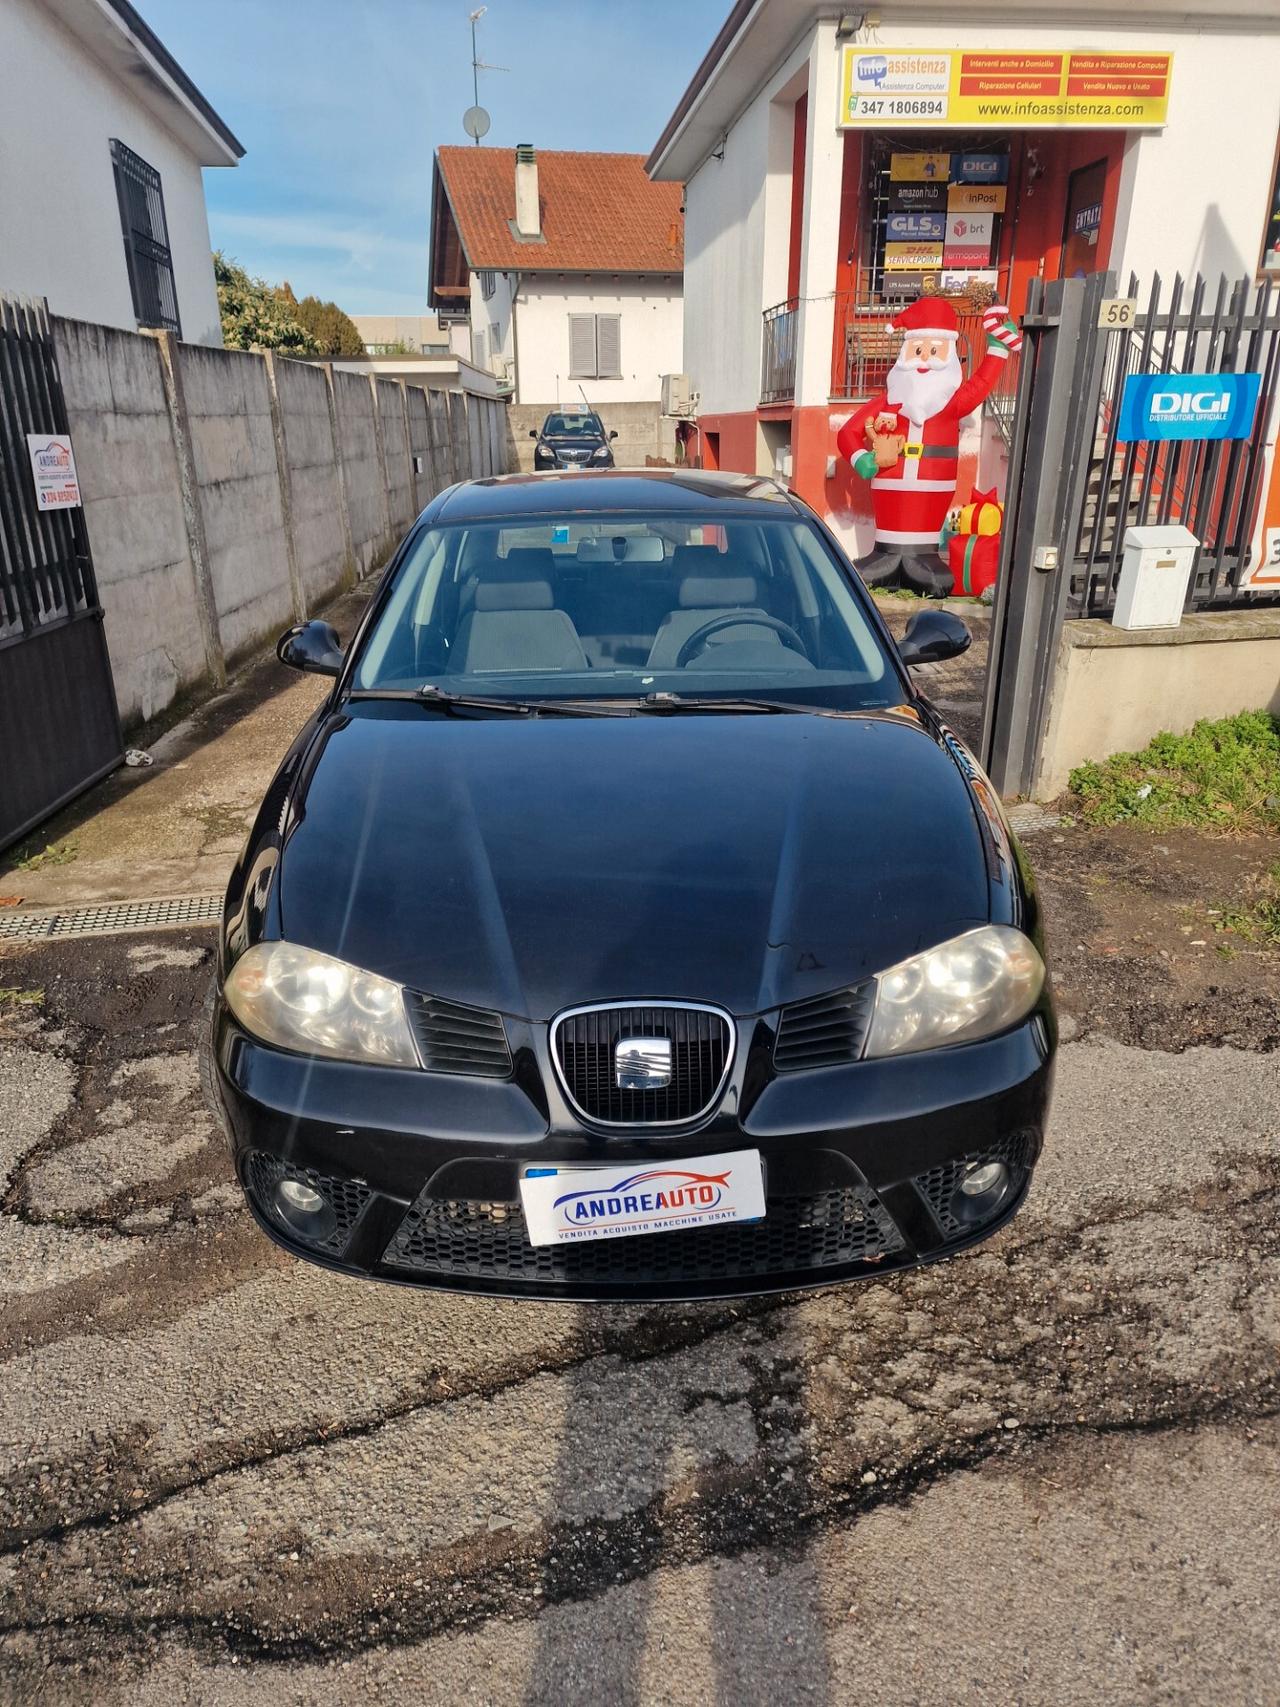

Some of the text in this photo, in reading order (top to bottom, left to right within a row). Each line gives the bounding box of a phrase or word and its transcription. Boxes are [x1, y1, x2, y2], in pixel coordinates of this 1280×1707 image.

[970, 60, 999, 68] Interventi
[1000, 60, 1018, 68] anche
[1025, 60, 1054, 68] Domicilio
[1072, 60, 1094, 68] Vendita
[1100, 61, 1136, 69] Riparazione
[1137, 62, 1167, 70] Computer
[882, 82, 945, 91] Assistenza Computer
[979, 81, 1042, 90] Riparazione Cellulari
[1083, 82, 1106, 90] Vendita
[1107, 82, 1126, 90] Nuovo
[1132, 82, 1150, 90] Usato
[861, 101, 943, 114] 347 1806894
[978, 102, 1144, 115] www.infoassistenza.com
[962, 161, 998, 171] DIGI
[898, 186, 939, 198] amazon hub
[891, 216, 932, 231] GLS
[970, 224, 985, 234] brt
[906, 246, 934, 254] DHL
[888, 256, 939, 264] SERVICEPOINT
[1107, 304, 1130, 323] 56
[1150, 392, 1231, 414] DIGI
[1149, 413, 1227, 422] DISTRIBUTORE UFFICIALE
[575, 1185, 714, 1220] ANDREAUTO
[559, 1211, 738, 1239] VENDITA ACQUISTO MACCHINE USATE
